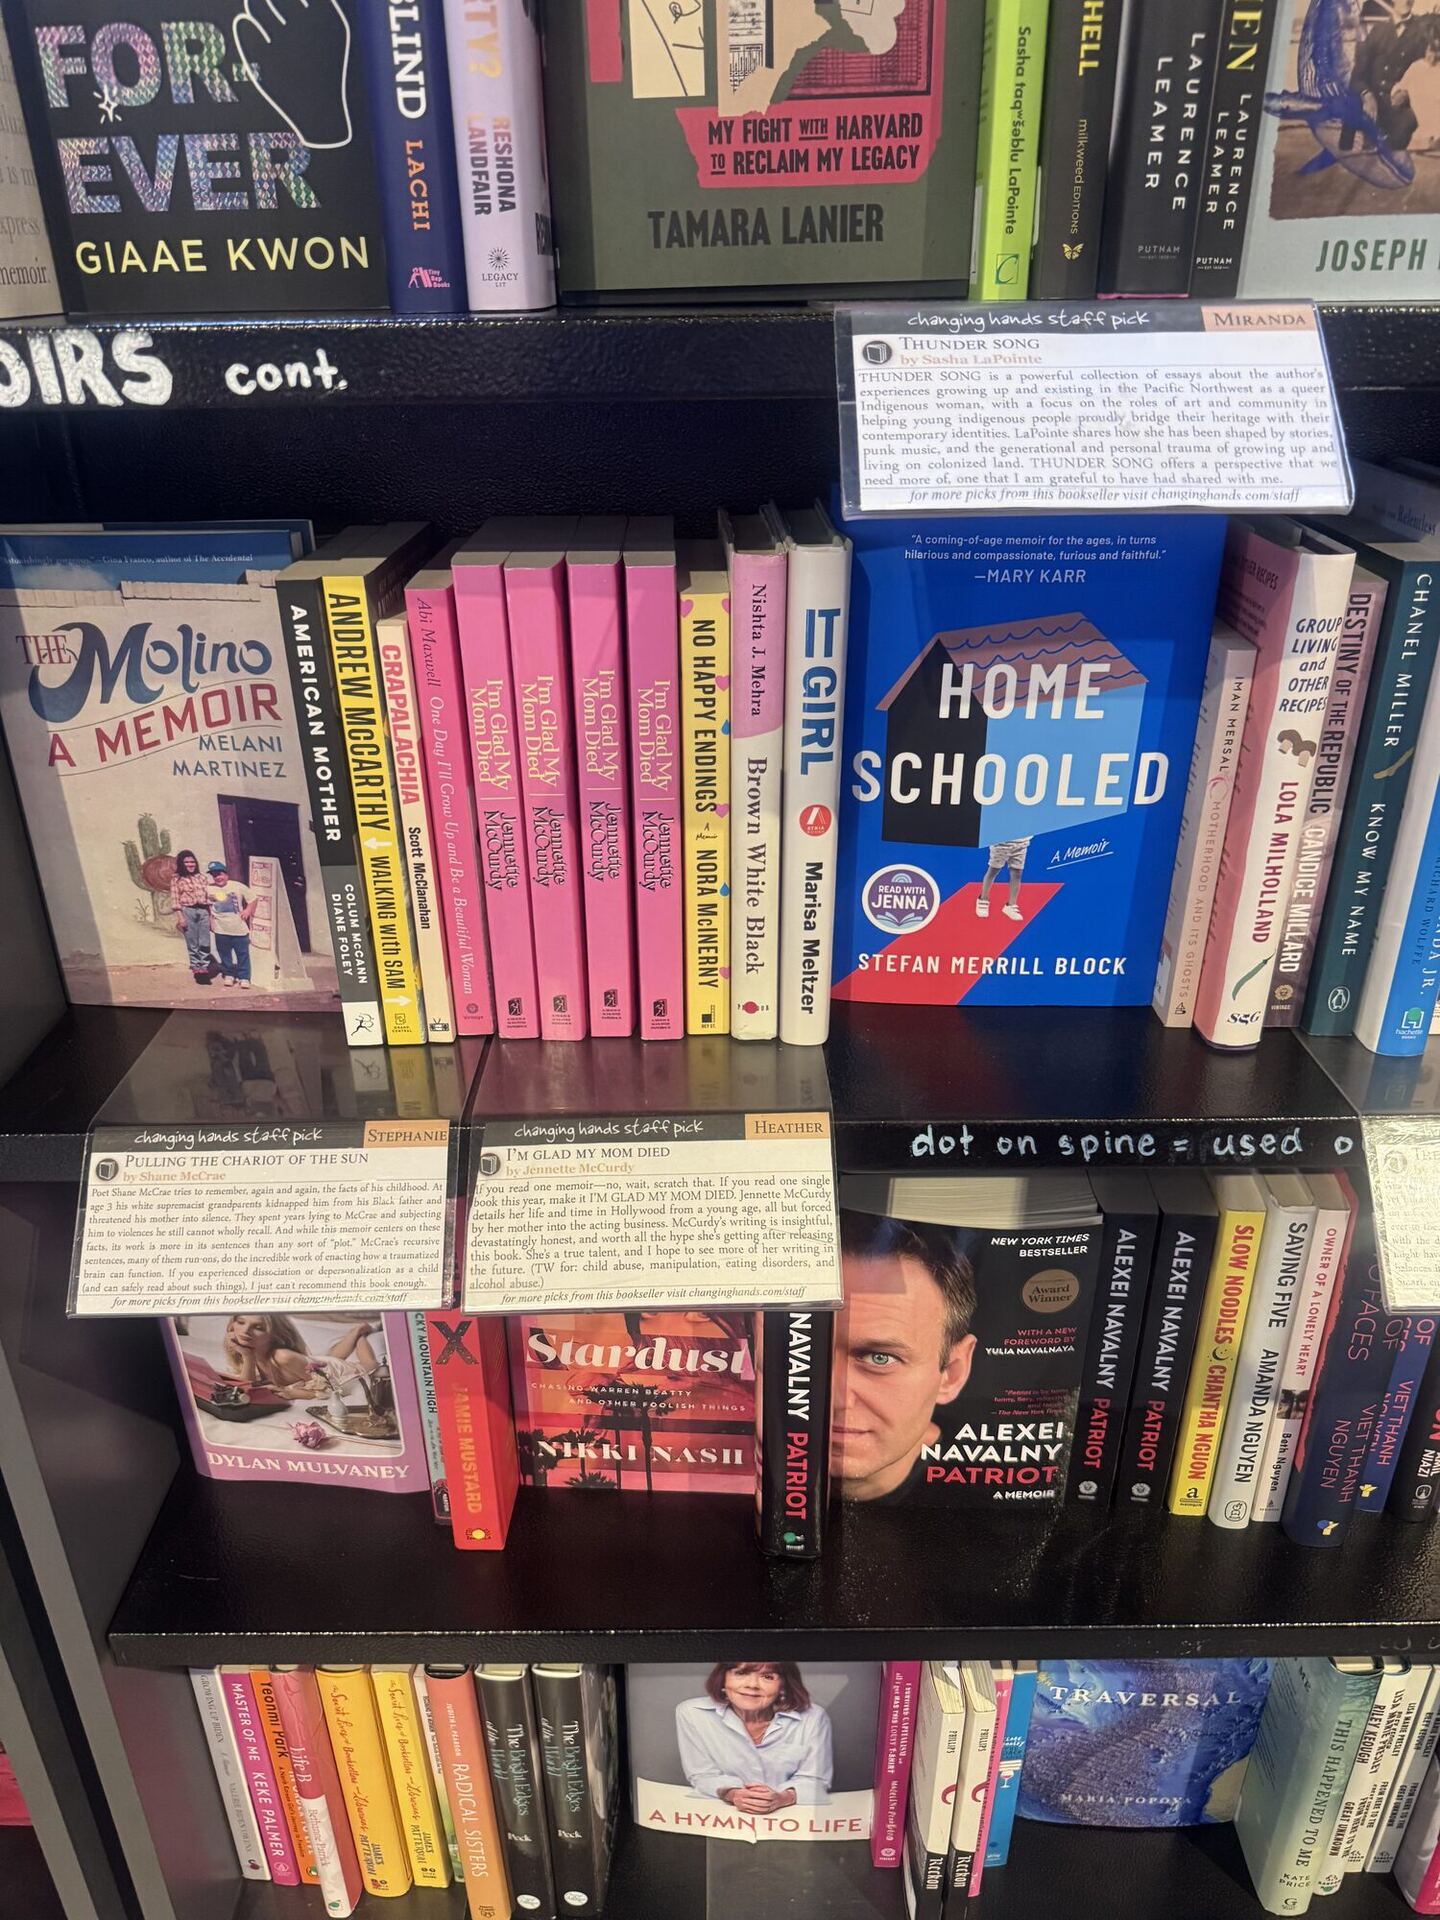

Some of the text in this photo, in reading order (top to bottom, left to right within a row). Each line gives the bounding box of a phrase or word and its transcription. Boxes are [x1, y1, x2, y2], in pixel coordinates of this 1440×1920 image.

[1016, 27, 1031, 76] Sasha
[708, 113, 922, 146] MY FIGHT WITH HARVARD
[1144, 56, 1174, 189] LEAMER
[1172, 33, 1206, 211] LAURENCE
[57, 133, 322, 213] EVER
[405, 139, 430, 231] LACHI
[467, 113, 492, 216] LANDFAIR
[492, 117, 516, 213] RESHONA
[711, 145, 920, 175] TO RECLAIM MY LEGACY
[1071, 119, 1087, 233] milkweed EDITIONS
[648, 204, 884, 249] TAMARA LANIER
[1005, 167, 1021, 234] LaPointe
[75, 237, 370, 275] GIAAE KWON
[481, 273, 518, 281] LEGACY
[1315, 239, 1428, 273] JOSEPH
[899, 337, 1039, 350] THUNDER SONG
[908, 309, 1149, 332] changing hands staff pick
[225, 349, 348, 394] cont.
[858, 372, 932, 382] THUNDER
[940, 371, 981, 381] SONG
[989, 372, 998, 380] is
[1020, 371, 1073, 383] powerful
[1080, 369, 1138, 380] collection
[1146, 370, 1158, 379] of
[1165, 371, 1201, 382] essays
[1208, 370, 1242, 379] about
[1250, 369, 1268, 379] the
[1275, 369, 1323, 379] author's
[16, 634, 73, 665] THE
[329, 593, 373, 699] ANDREW
[751, 584, 767, 716] Nishta J. Mehra
[1292, 638, 1338, 653] LIVING
[1296, 618, 1342, 633] GROUP
[28, 622, 272, 723] Molino
[1288, 676, 1329, 692] OTHER
[1299, 658, 1326, 672] and
[1384, 573, 1432, 747] CHANEL MILLER
[692, 620, 718, 813] NO HAPPY ENDINGS
[800, 608, 841, 775] IT GIRL
[938, 662, 1111, 721] HOME
[1279, 697, 1327, 713] RECIPES
[48, 683, 282, 768] A MEMOIR
[199, 734, 282, 752] MELANI
[290, 604, 342, 843] AMERICAN MOTHER
[638, 688, 656, 783] Mom Died
[653, 680, 673, 792] I'm Glad My
[172, 761, 287, 778] MARTINEZ
[380, 644, 430, 929] CRAPALACHIA Scott McClanahan
[851, 750, 1169, 808] SCHOOLED
[640, 811, 658, 892] McCurdy
[659, 813, 674, 889] Jennette
[746, 756, 768, 974] Brown White Black
[1252, 780, 1299, 943] LOLA MILHOLLAND
[345, 884, 359, 928] COLUM
[871, 893, 929, 912] JENNA
[878, 884, 926, 896] READ WITH
[1342, 803, 1386, 956] KNOW MY NAME
[332, 894, 353, 976] DIANE FOLEY
[370, 856, 397, 920] WALKING
[384, 959, 405, 989] SAM
[696, 850, 719, 988] NORA McINERNY
[801, 862, 823, 1015] Marisa Meltzer
[858, 953, 1128, 976] STEFAN MERRILL BLOCK
[125, 1153, 369, 1168] PULLING THE CHARIOT OF THE SUN
[533, 1150, 571, 1160] GLAD
[576, 1149, 595, 1159] MY
[601, 1149, 632, 1158] MOM
[637, 1147, 670, 1159] DIED
[911, 1124, 1302, 1161] dot on spine used
[991, 1234, 1089, 1246] NEW YORK TIMES
[1019, 1246, 1087, 1257] BESTSELLER
[1214, 1225, 1254, 1345] SLOW NOODLES
[785, 1313, 811, 1519] NAVALNY PATRIOT
[955, 1422, 1063, 1441] ALEXEI
[1234, 1349, 1279, 1483] AMANDA NGUYEN
[208, 1453, 410, 1479] DYLAN MULVANEY
[537, 1441, 744, 1464] NIKKI NASH
[921, 1444, 1064, 1462] NAVALNY
[926, 1466, 1058, 1484] PATRIOT
[231, 1683, 260, 1761] MASTER OF ME
[1050, 1686, 1242, 1706] TRAVERSAL
[252, 1772, 284, 1857] KEKE PALMER
[453, 1763, 479, 1823] RADICAL
[649, 1810, 861, 1833] A HYMN TO LIFE
[464, 1830, 488, 1878] SISTERS
